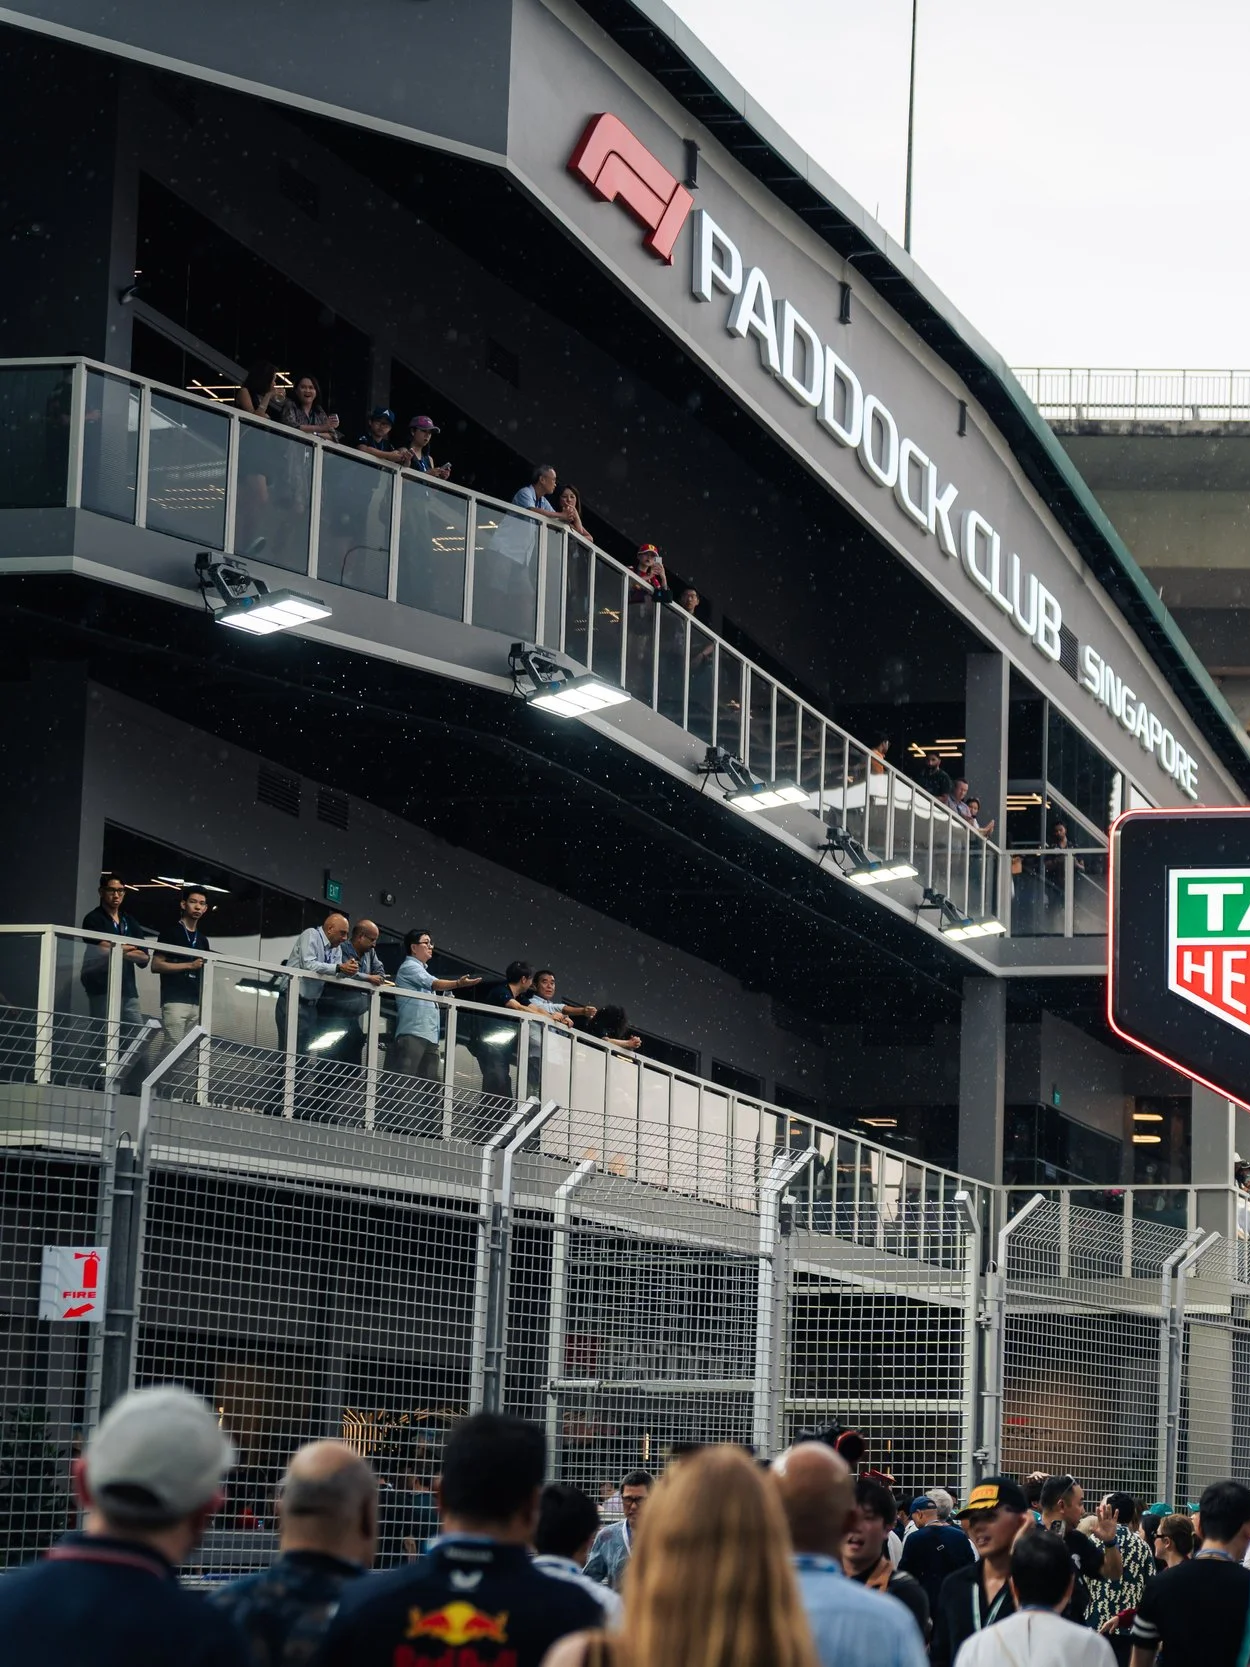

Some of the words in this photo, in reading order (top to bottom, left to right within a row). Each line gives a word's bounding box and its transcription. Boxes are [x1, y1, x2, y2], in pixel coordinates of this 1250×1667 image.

[693, 209, 959, 559] PADDOCK
[961, 510, 1062, 662] CLUB
[1078, 644, 1199, 800] SINGAPORE
[63, 1291, 97, 1299] FIRE
